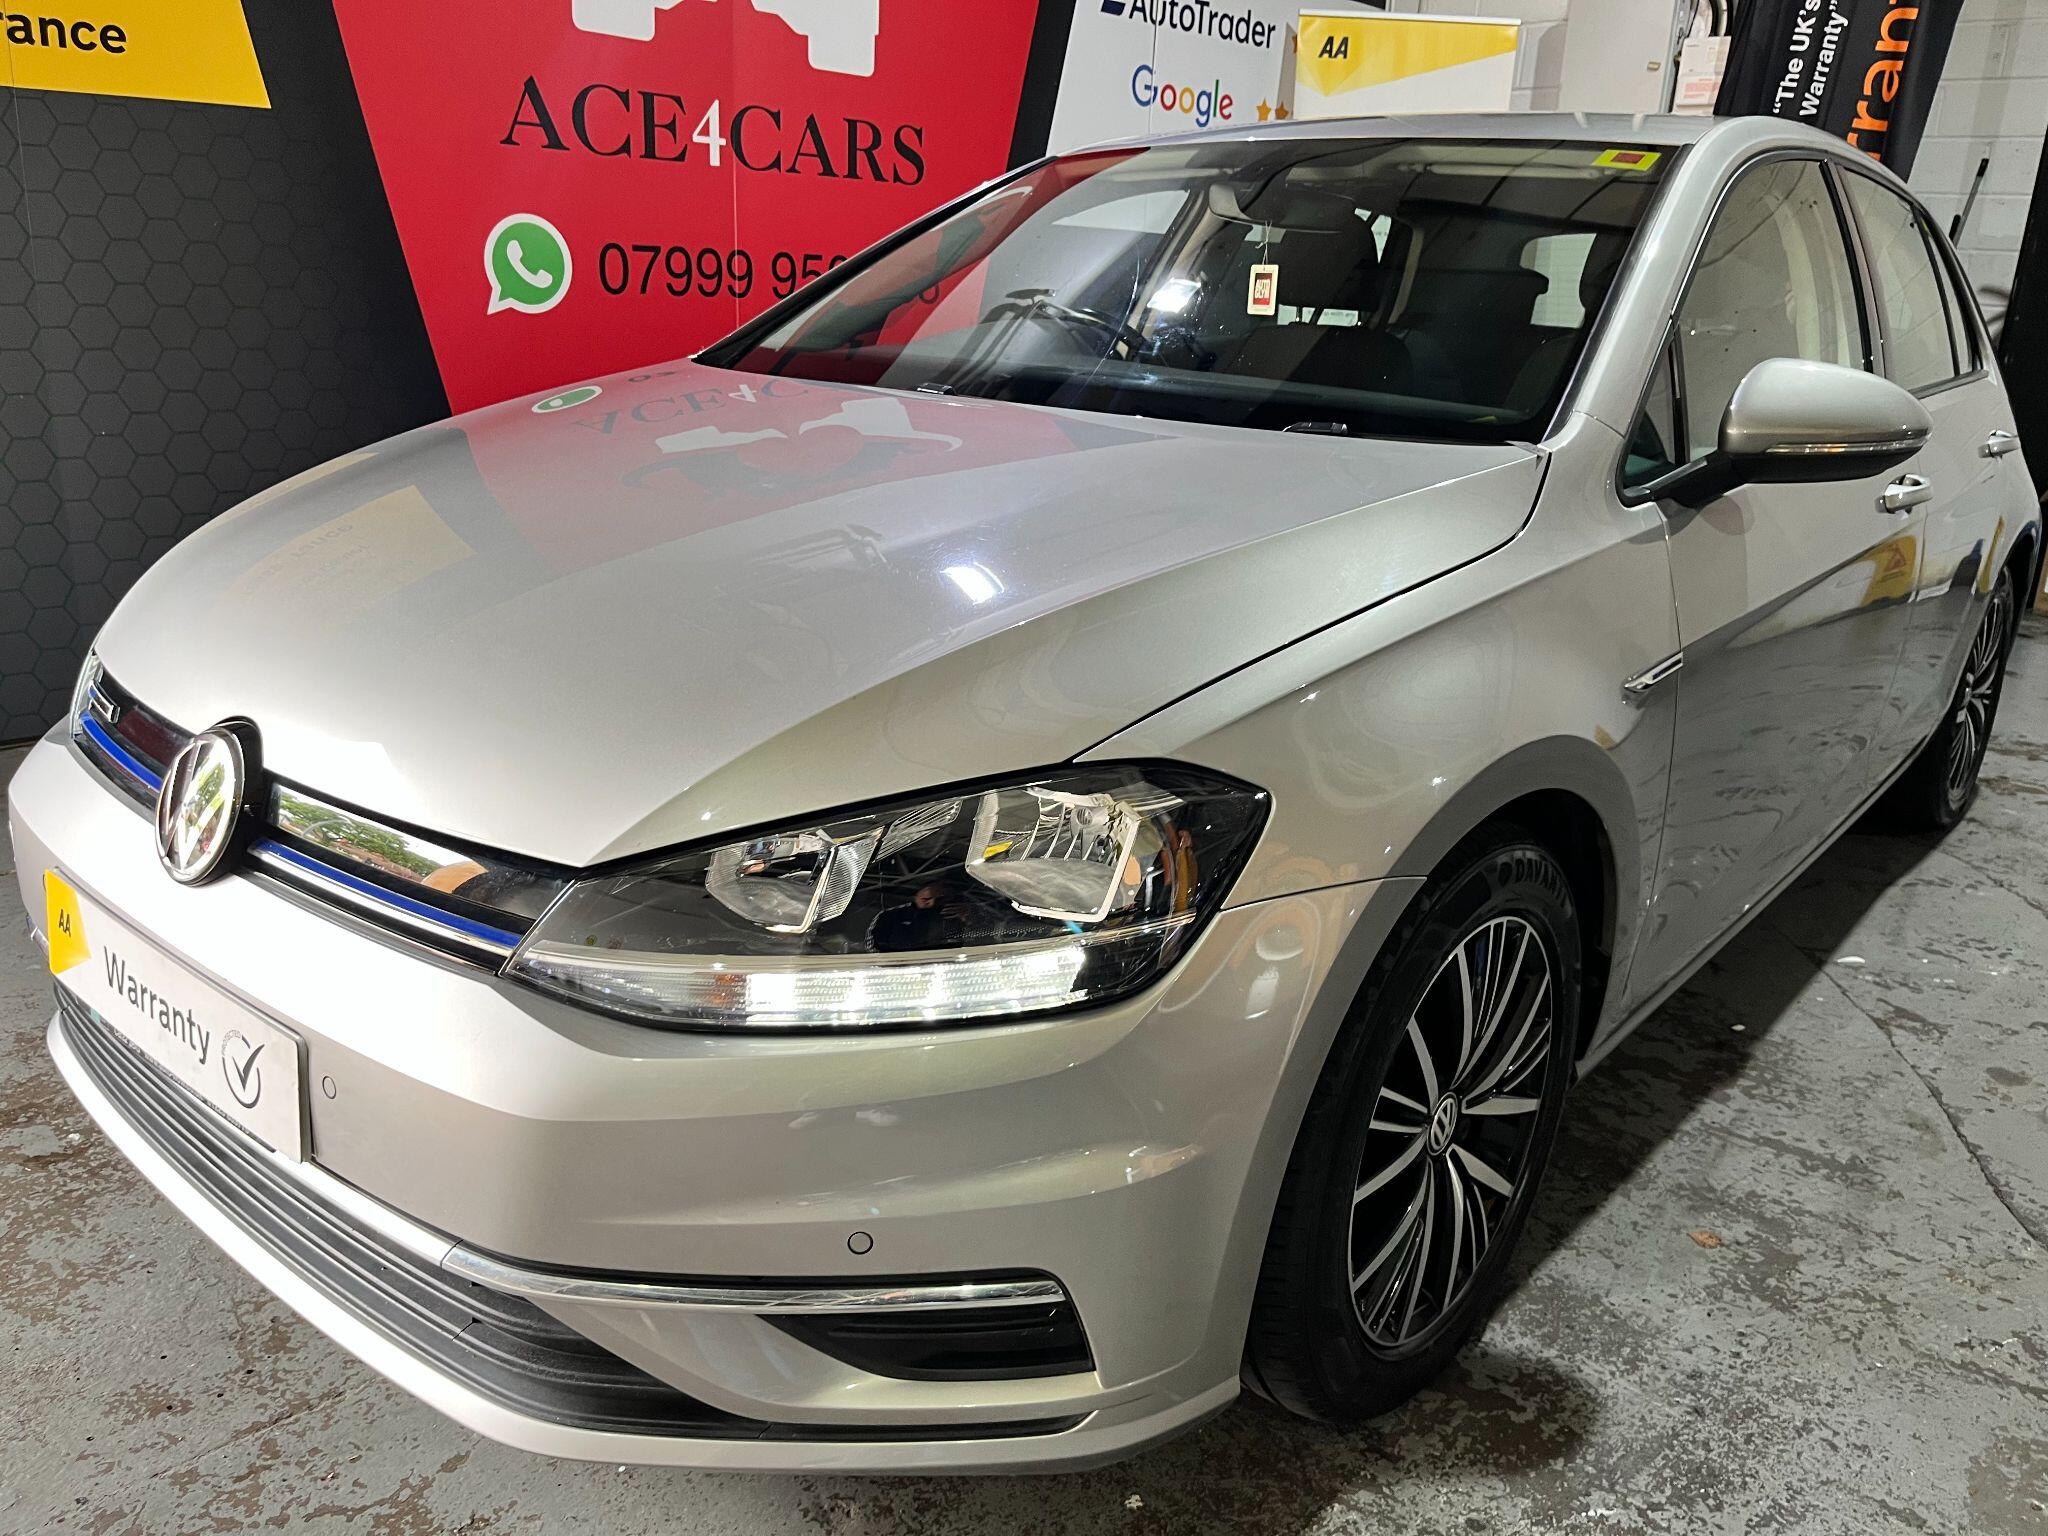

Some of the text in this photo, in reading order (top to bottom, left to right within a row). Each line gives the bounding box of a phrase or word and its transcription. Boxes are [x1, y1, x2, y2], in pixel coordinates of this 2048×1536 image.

[0, 12, 127, 54] ance
[1128, 0, 1276, 49] AutoTrader
[1318, 36, 1350, 60] AA
[1131, 64, 1234, 128] Google
[500, 75, 925, 186] ACE4CARS
[599, 242, 753, 299] 07999
[58, 908, 72, 938] AA
[103, 945, 211, 1065] Warranty
